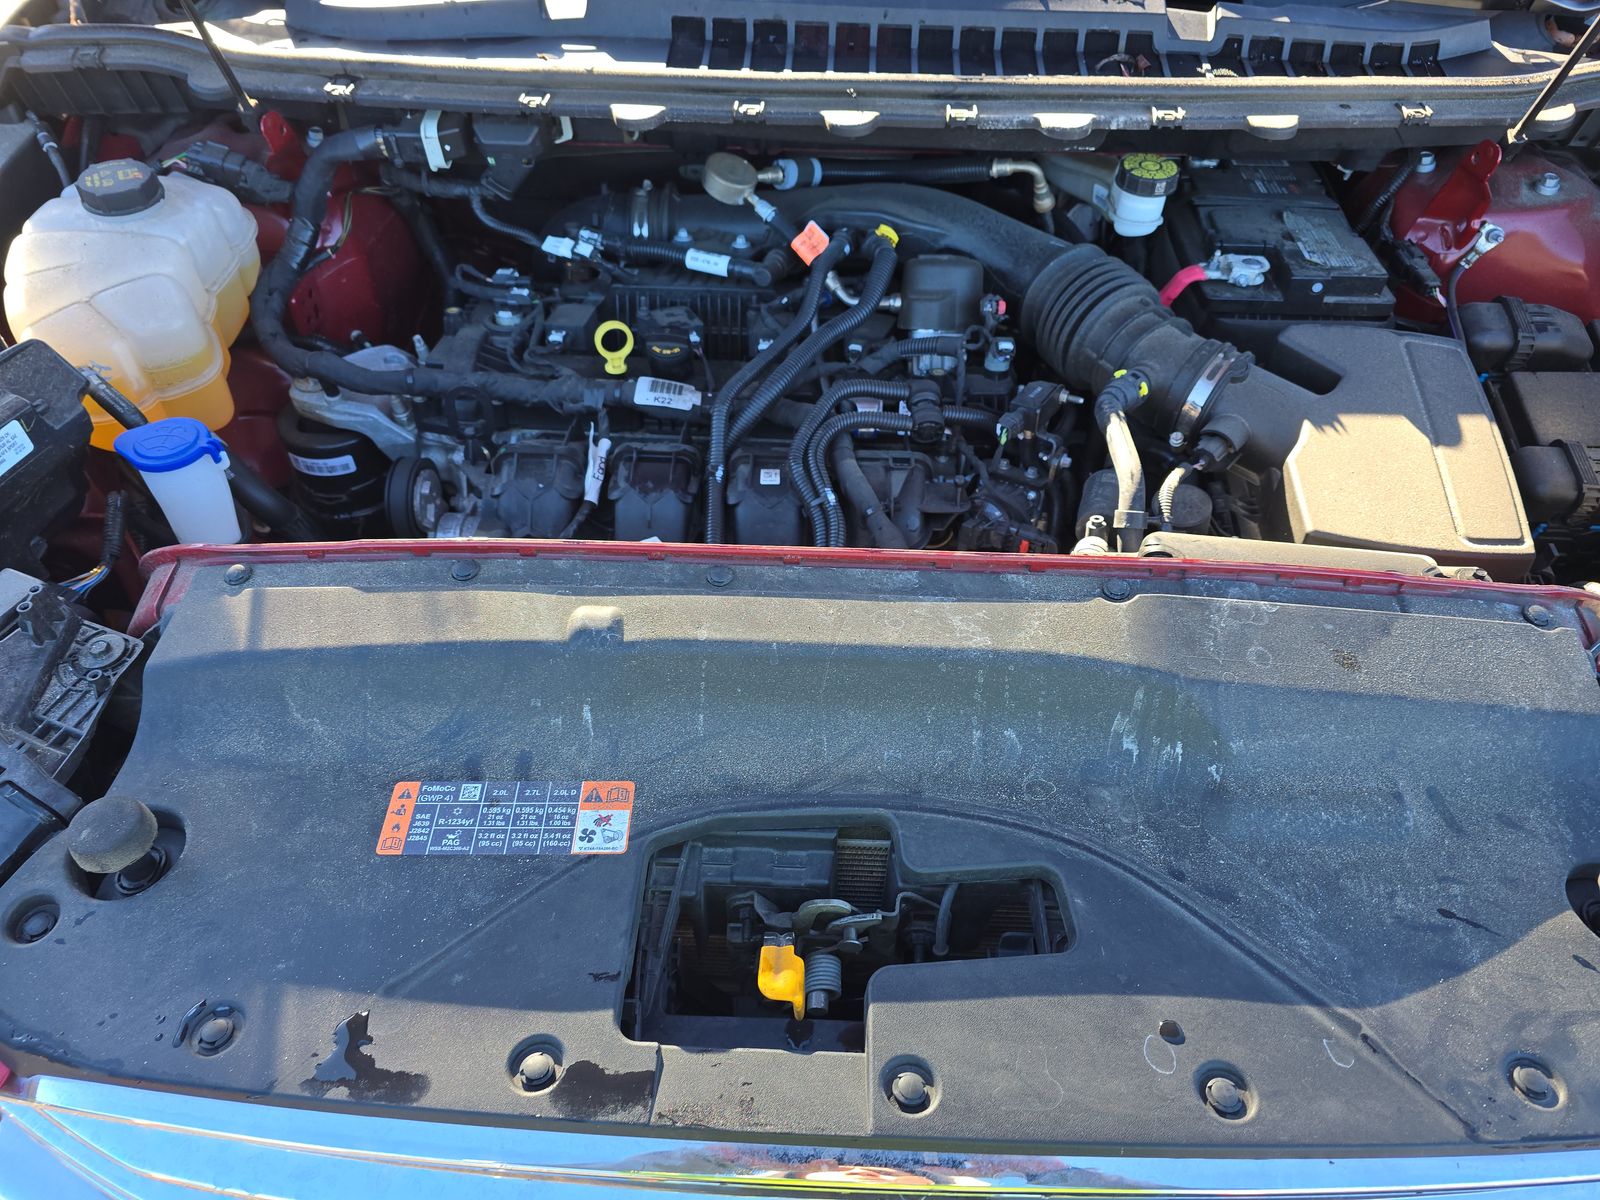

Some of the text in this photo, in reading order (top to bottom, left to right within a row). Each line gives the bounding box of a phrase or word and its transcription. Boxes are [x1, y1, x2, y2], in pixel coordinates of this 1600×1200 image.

[653, 396, 673, 405] K22
[502, 807, 511, 815] kg
[534, 807, 544, 815] kg
[567, 807, 577, 815] kg
